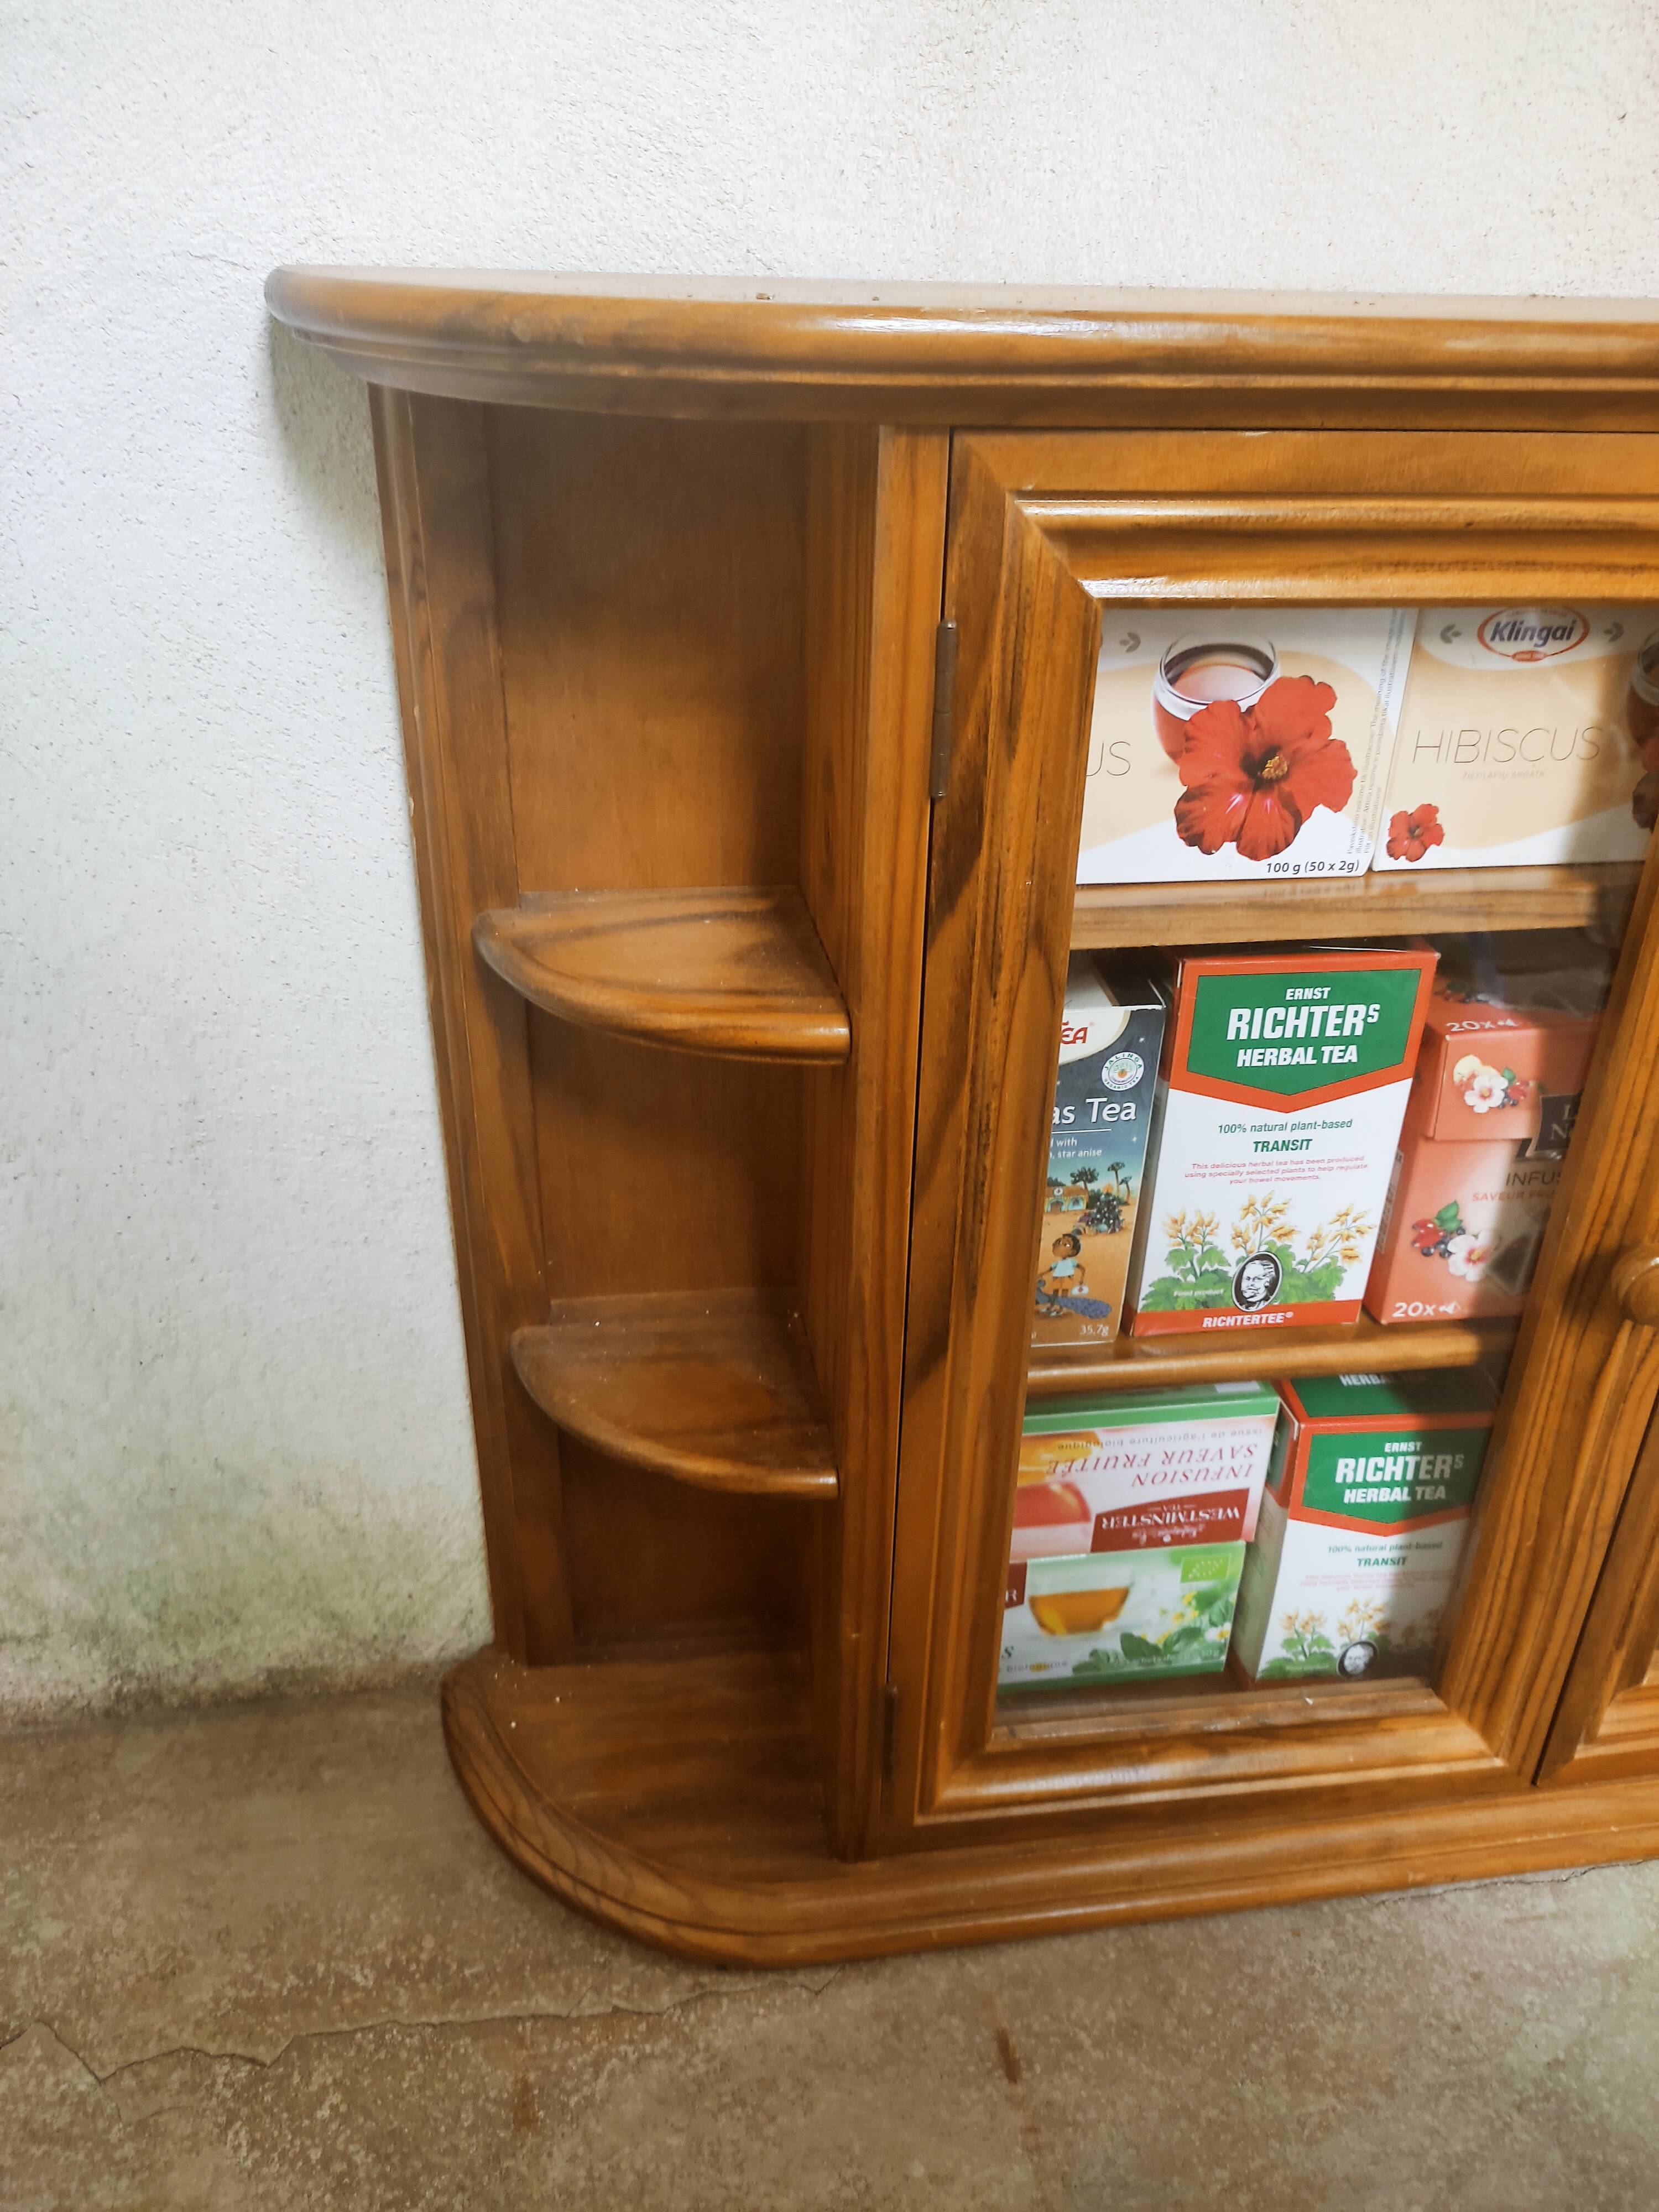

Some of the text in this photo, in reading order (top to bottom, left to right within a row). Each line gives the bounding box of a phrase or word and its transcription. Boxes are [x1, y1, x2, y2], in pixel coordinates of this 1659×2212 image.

[1490, 619, 1577, 648] Klingai
[1412, 726, 1603, 764] HIBISCUS
[1266, 859, 1360, 875] 100 g (50 x 2g)
[1285, 987, 1331, 1000] ERNST
[1237, 1045, 1359, 1067] HERBAL TEA
[1085, 1097, 1137, 1123] Tea
[1218, 1119, 1353, 1135] 100% natural plant-based
[1056, 1137, 1077, 1147] with
[1253, 1138, 1313, 1153] TRANSIT
[1057, 1150, 1076, 1159] star
[1078, 1147, 1102, 1157] anise
[1058, 1438, 1124, 1451] biologique
[1384, 1441, 1422, 1453] ERNST
[1046, 1443, 1258, 1478] SAVEUR FRUITÉE
[1132, 1463, 1253, 1487] INFUSION
[1344, 1485, 1446, 1504] HERBAL TEA
[1102, 1506, 1240, 1530] WESTMINSTER
[1328, 1545, 1352, 1553] 100%
[1354, 1543, 1387, 1552] natural
[1357, 1556, 1408, 1567] TRANSIT
